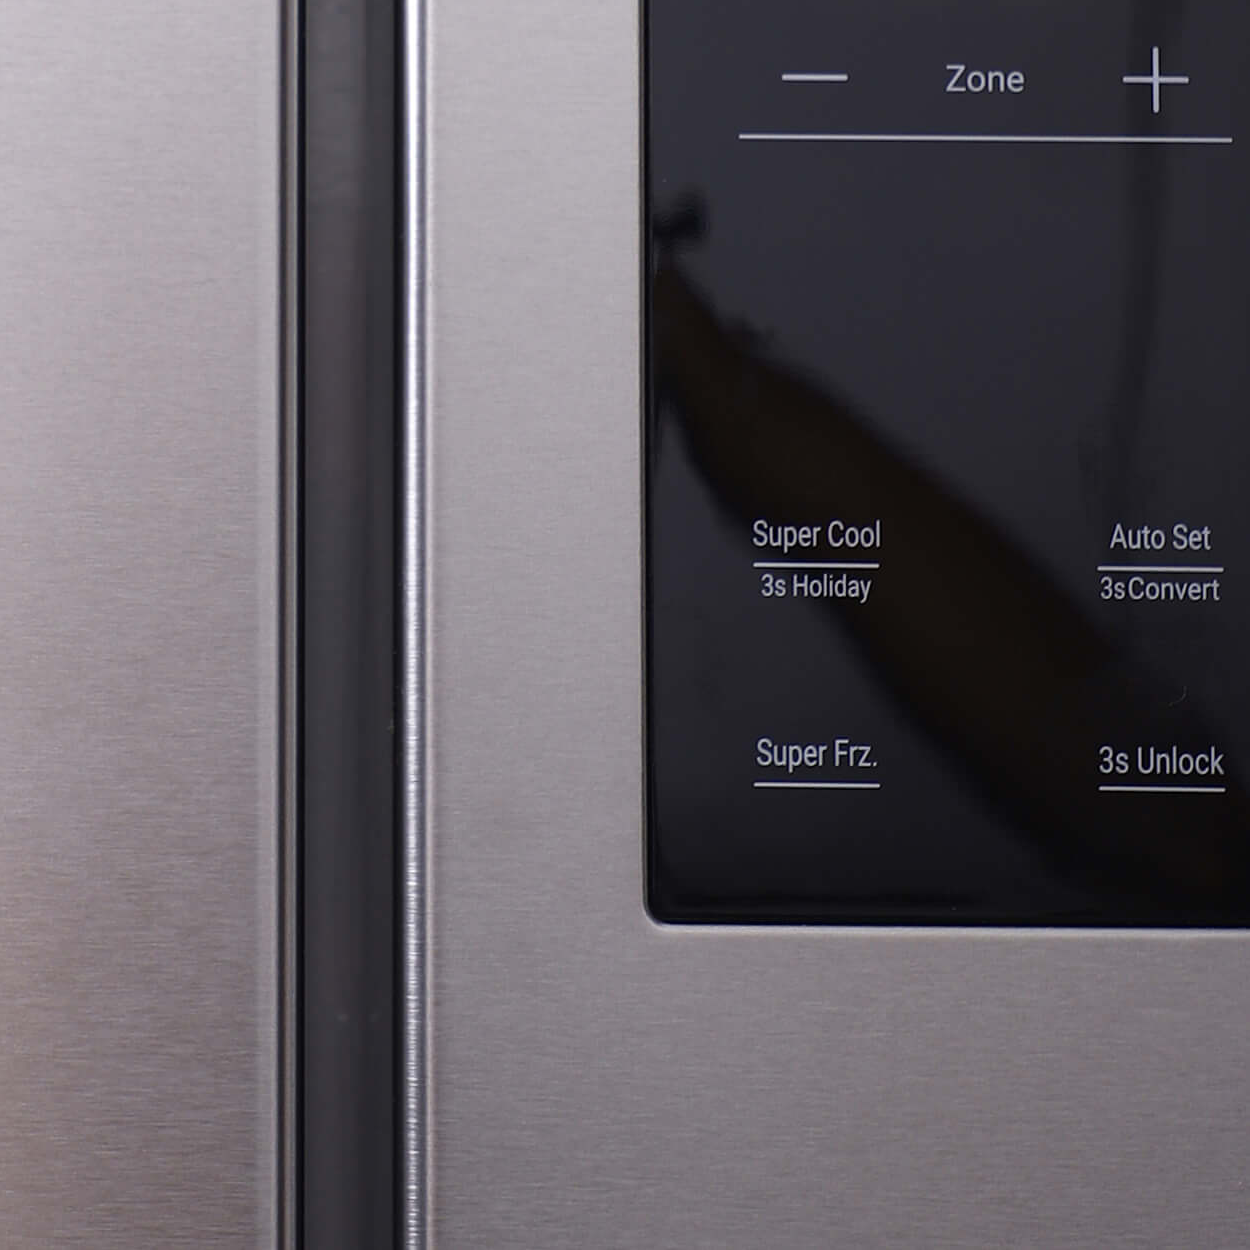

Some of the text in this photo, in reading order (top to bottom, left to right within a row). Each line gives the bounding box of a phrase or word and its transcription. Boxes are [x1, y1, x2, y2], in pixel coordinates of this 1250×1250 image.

[945, 64, 1025, 93] Zone
[752, 519, 881, 554] Super Cool
[1109, 523, 1212, 551] Auto Set
[761, 573, 872, 604] 3s Holiday
[756, 737, 878, 774] Super Frz.
[1098, 745, 1225, 775] 3s Unlock
